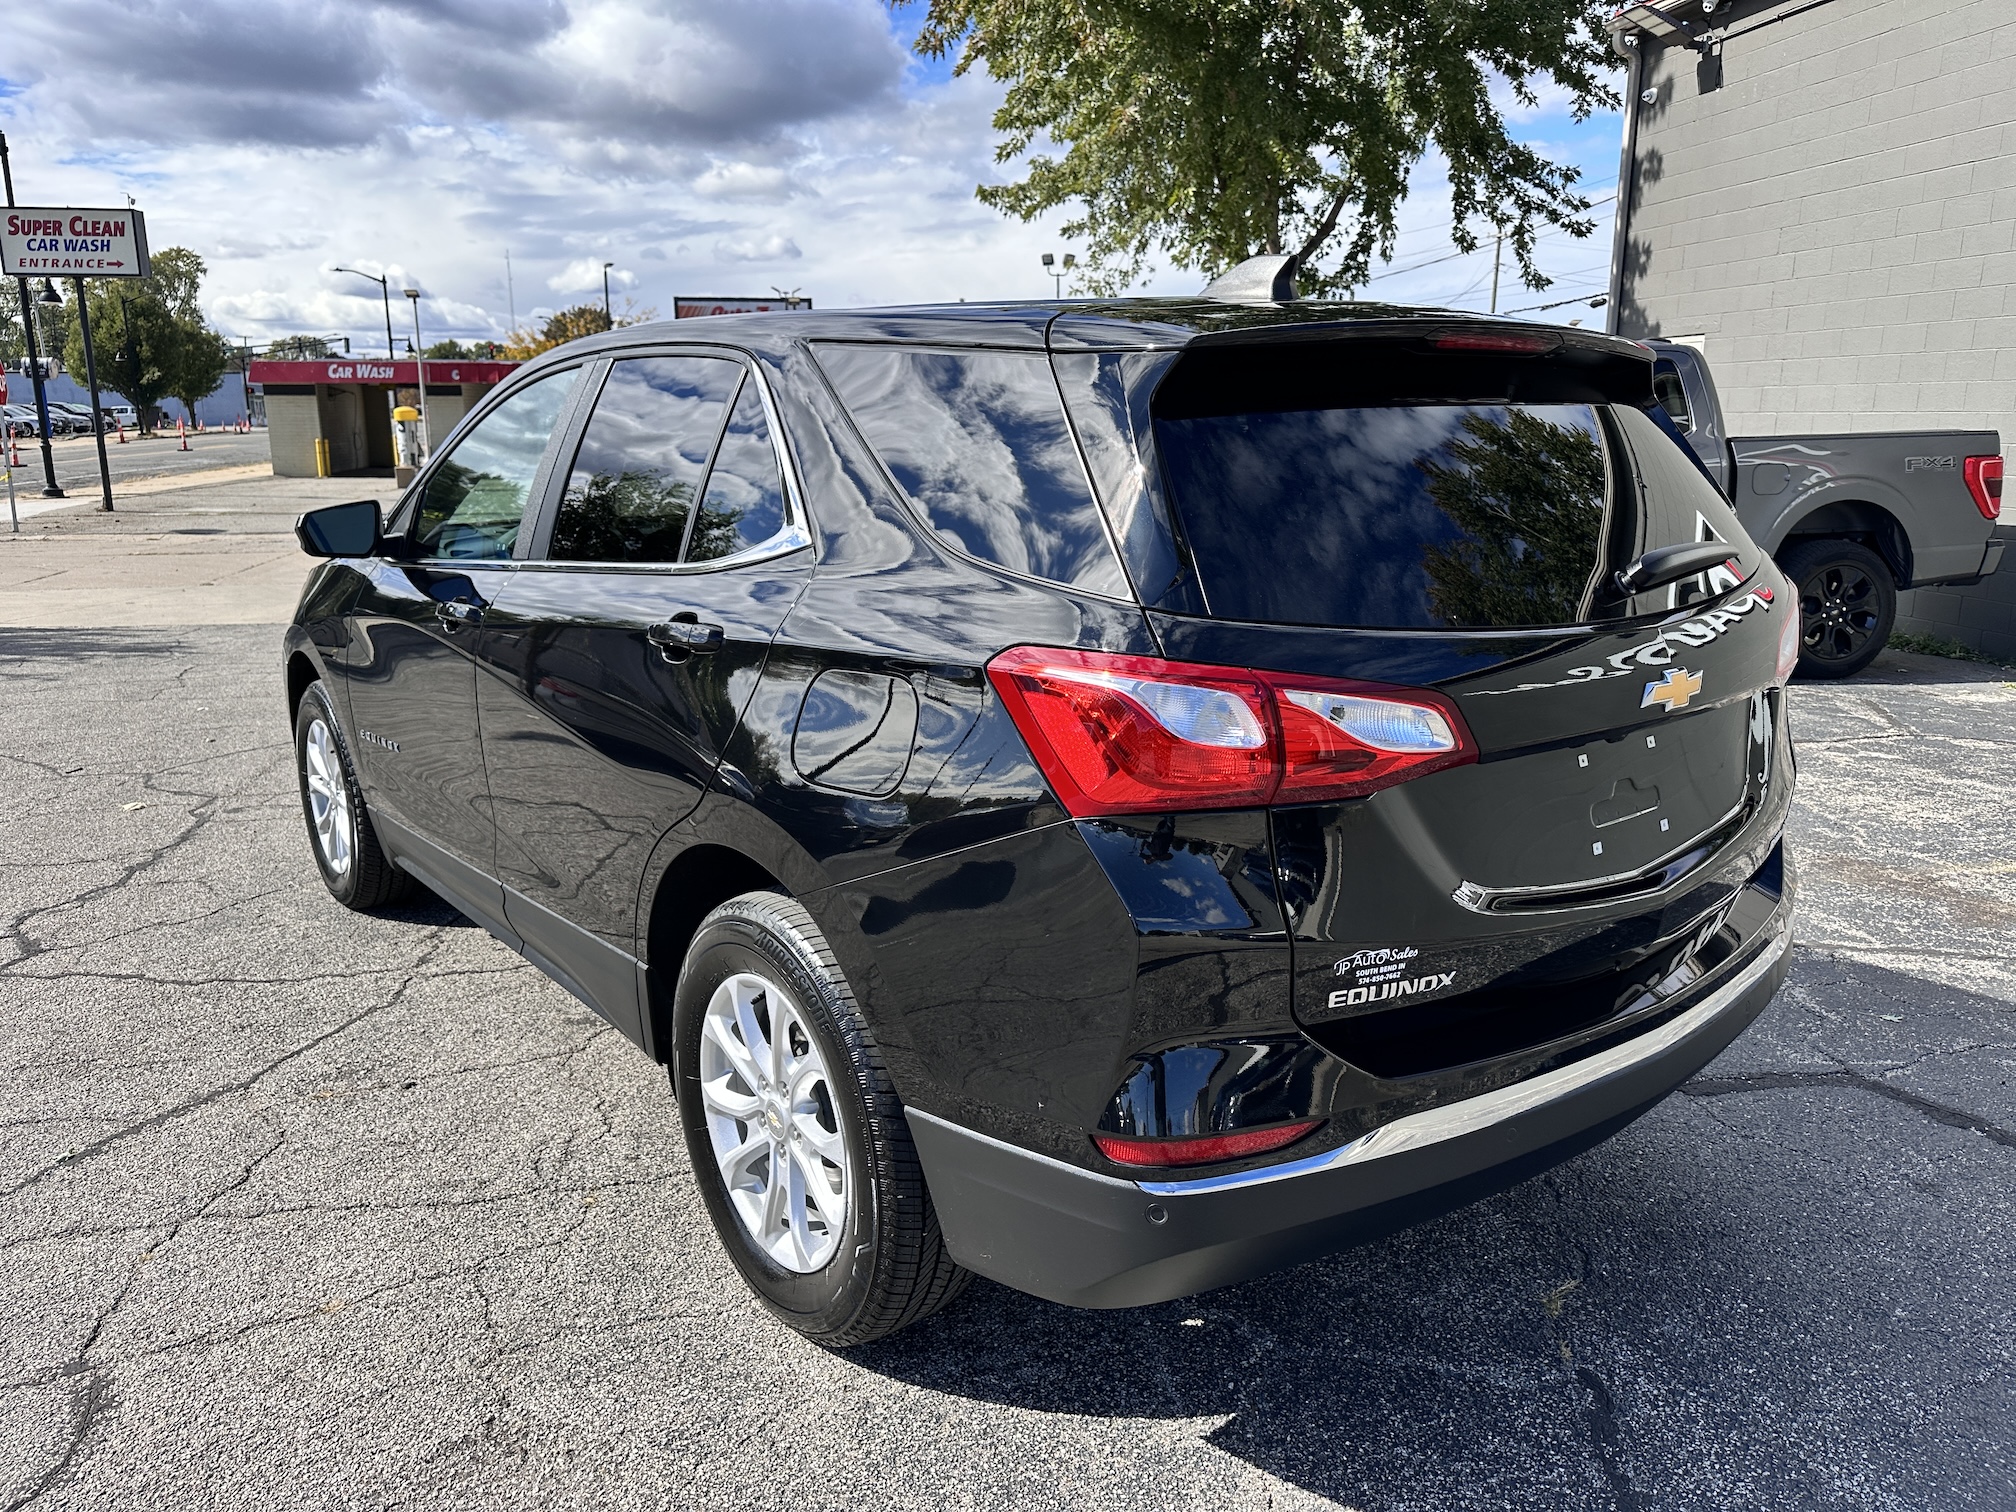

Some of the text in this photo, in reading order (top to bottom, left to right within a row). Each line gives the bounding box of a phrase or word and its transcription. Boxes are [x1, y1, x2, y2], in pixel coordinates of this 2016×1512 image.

[8, 215, 126, 237] SUPER CLEAN
[26, 238, 111, 252] CAR WASH
[19, 258, 105, 269] ENTRANCE
[328, 363, 395, 379] CAR WASH
[1904, 456, 1957, 473] FX4
[360, 729, 400, 753] EQUINOX
[1335, 946, 1419, 976] JP Auto Sales
[1355, 962, 1407, 978] SOUTH BEND IN
[754, 930, 834, 1036] BRIDGESTONE
[1327, 971, 1457, 1009] EQUINOX
